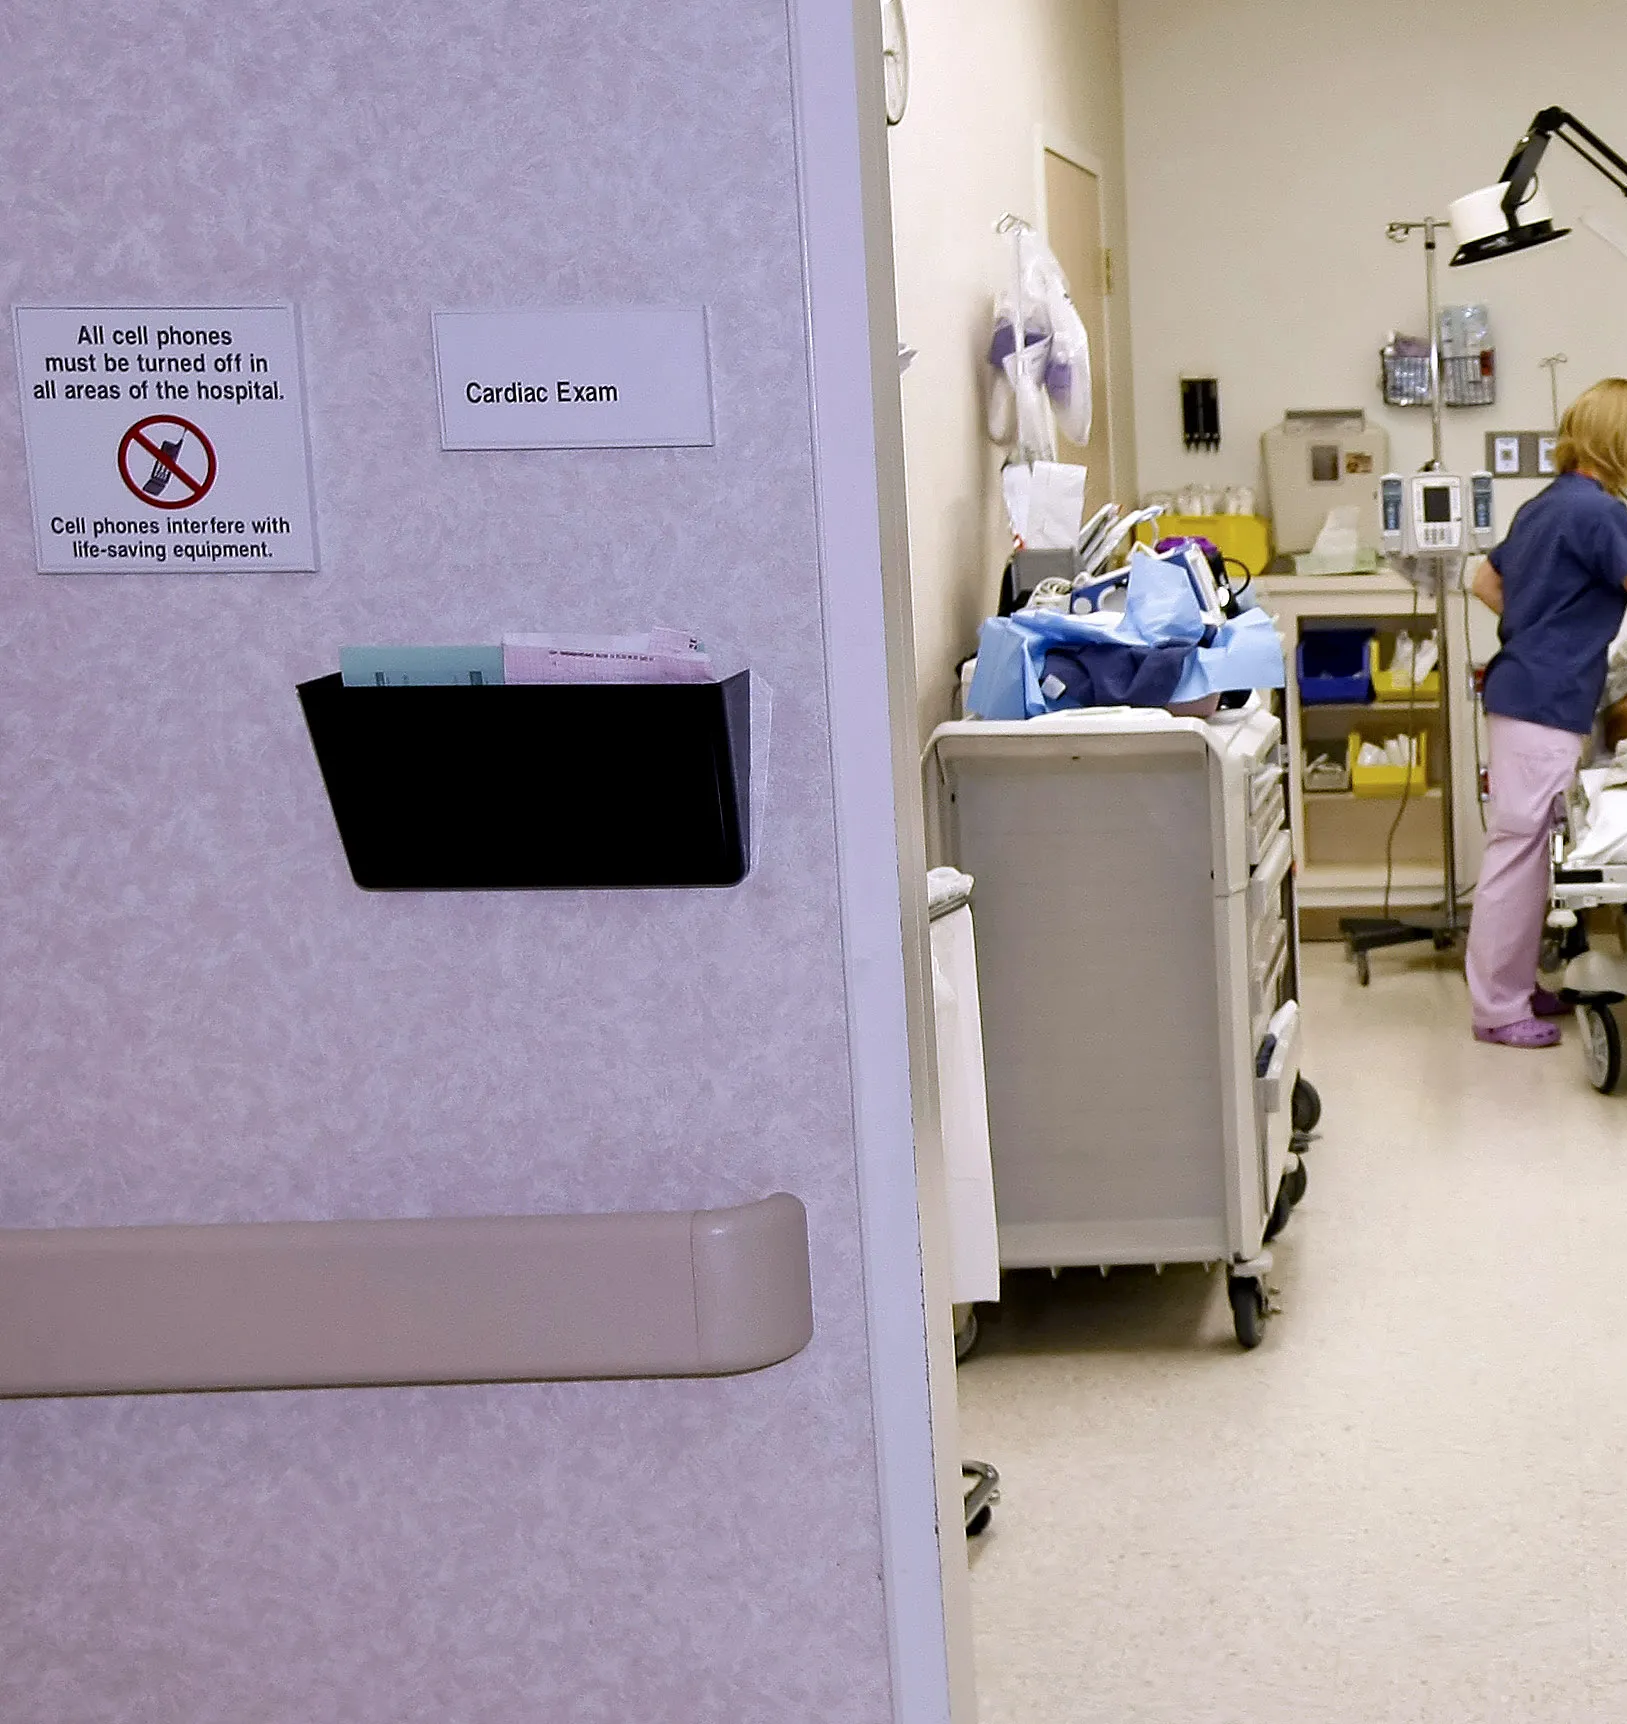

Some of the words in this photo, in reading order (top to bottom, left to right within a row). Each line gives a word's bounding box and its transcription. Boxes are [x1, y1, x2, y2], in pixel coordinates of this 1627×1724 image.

[78, 326, 104, 344] All
[113, 326, 148, 345] cell
[157, 326, 232, 350] phones
[45, 354, 96, 372] must
[104, 353, 129, 372] be
[137, 353, 205, 372] turned
[214, 353, 241, 372] off
[250, 353, 267, 372] in
[34, 380, 56, 399] all
[65, 385, 120, 399] areas
[129, 380, 148, 399] of
[156, 380, 188, 399] the
[197, 381, 284, 404] hospital.
[467, 382, 548, 403] Cardiac
[557, 382, 617, 402] Exam
[51, 517, 85, 534] Cell
[94, 517, 159, 538] phones
[167, 517, 244, 533] interfere
[252, 517, 290, 533] with
[73, 541, 166, 562] life-saving
[174, 541, 272, 562] equipment.
